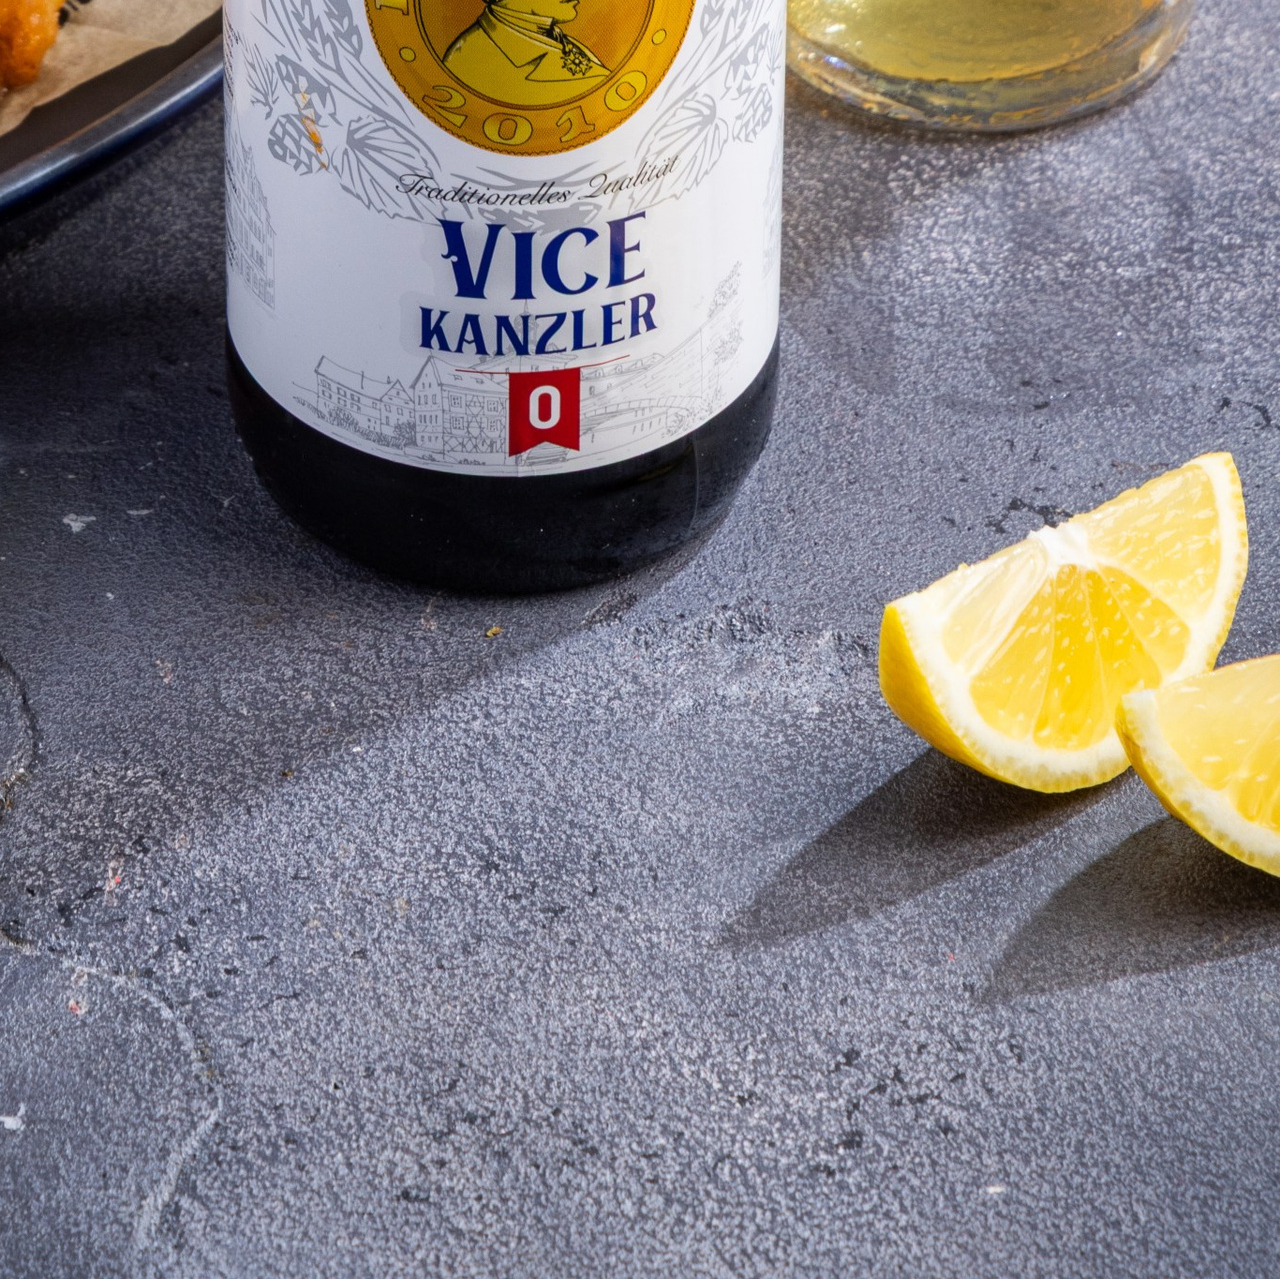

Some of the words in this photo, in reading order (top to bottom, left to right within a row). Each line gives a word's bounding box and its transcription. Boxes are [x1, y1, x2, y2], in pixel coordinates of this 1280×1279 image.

[421, 70, 648, 147] 2010
[394, 172, 572, 207] Traditionelles
[577, 154, 680, 202] Qualität
[436, 210, 647, 301] VICE
[418, 291, 658, 357] KANZLER
